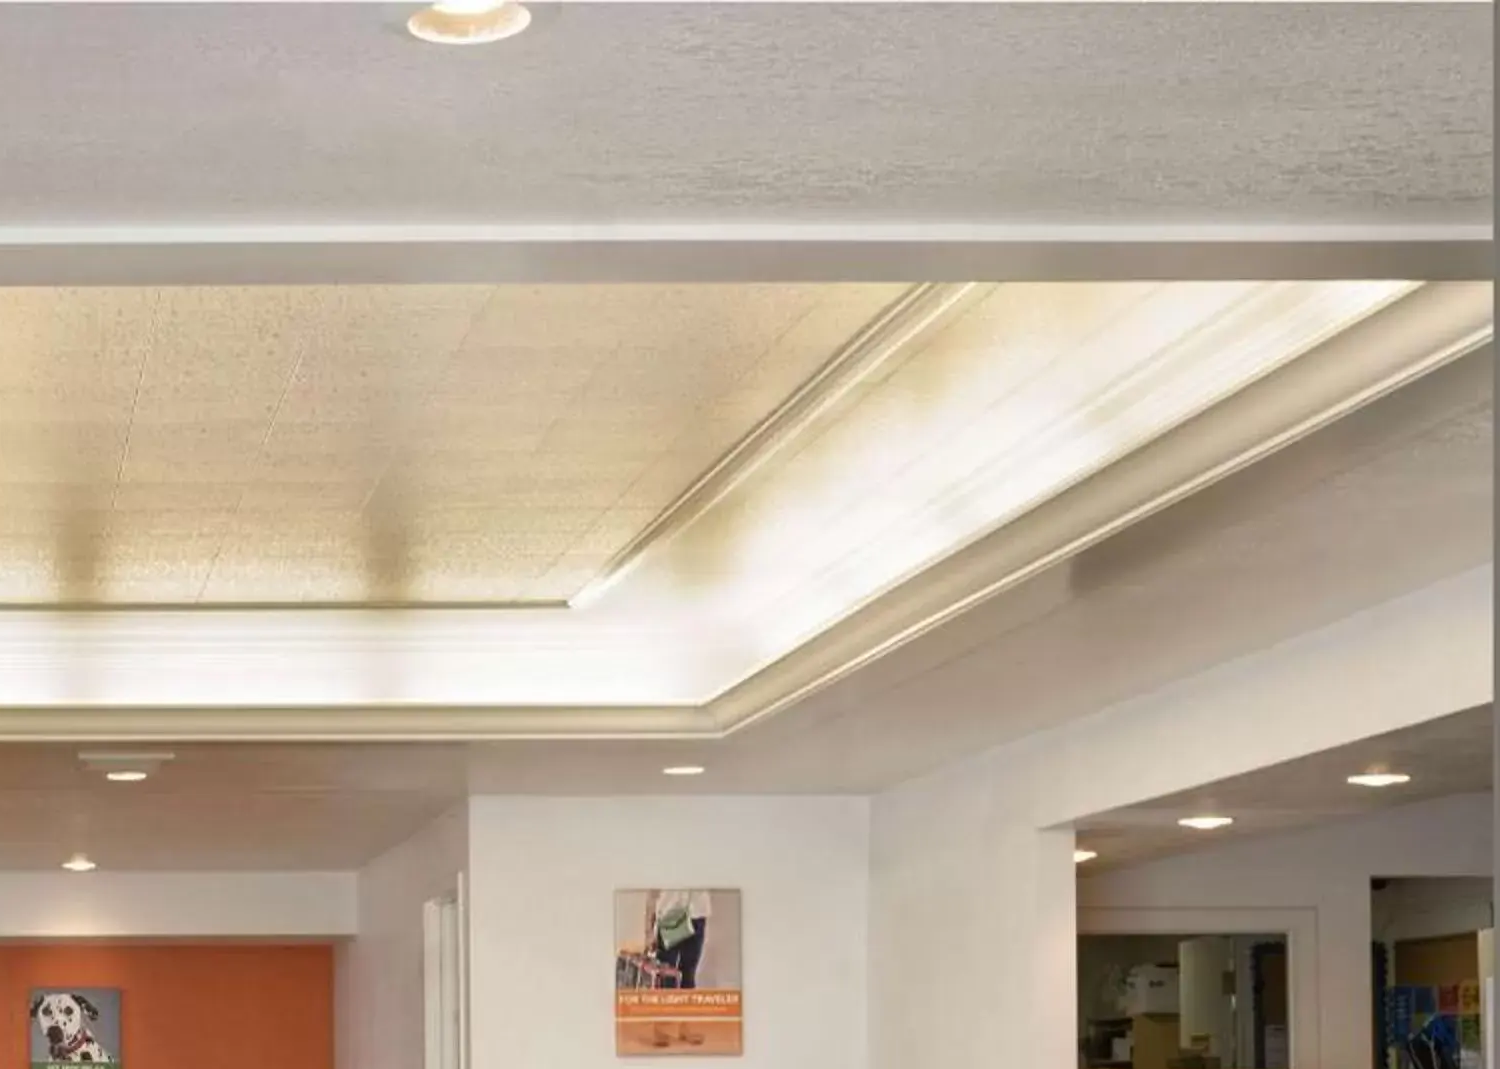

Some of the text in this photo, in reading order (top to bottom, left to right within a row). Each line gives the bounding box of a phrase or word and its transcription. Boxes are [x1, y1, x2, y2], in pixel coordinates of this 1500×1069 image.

[619, 992, 739, 1005] FOR THE LIGHT TRAVELER
